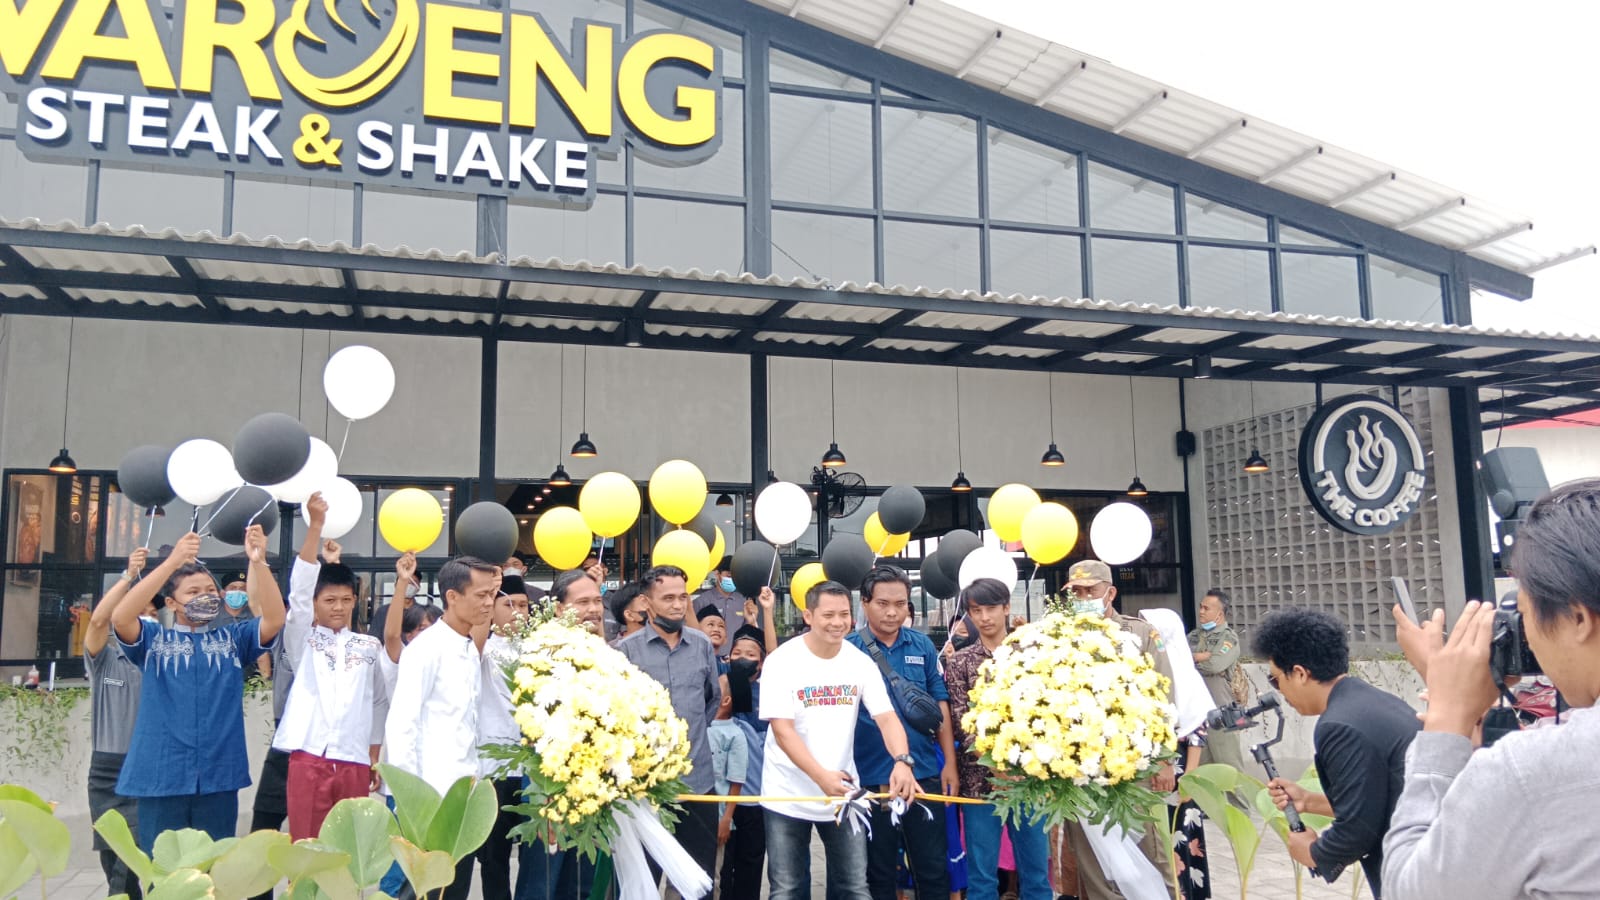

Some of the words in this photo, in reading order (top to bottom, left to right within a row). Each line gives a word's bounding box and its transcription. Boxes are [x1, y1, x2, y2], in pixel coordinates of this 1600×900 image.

[25, 87, 284, 160] STEAK
[293, 114, 343, 168] &
[356, 121, 589, 190] SHAKE
[1317, 470, 1357, 520] THE
[1354, 471, 1425, 527] COFFEE
[797, 684, 858, 701] STEAKNYA
